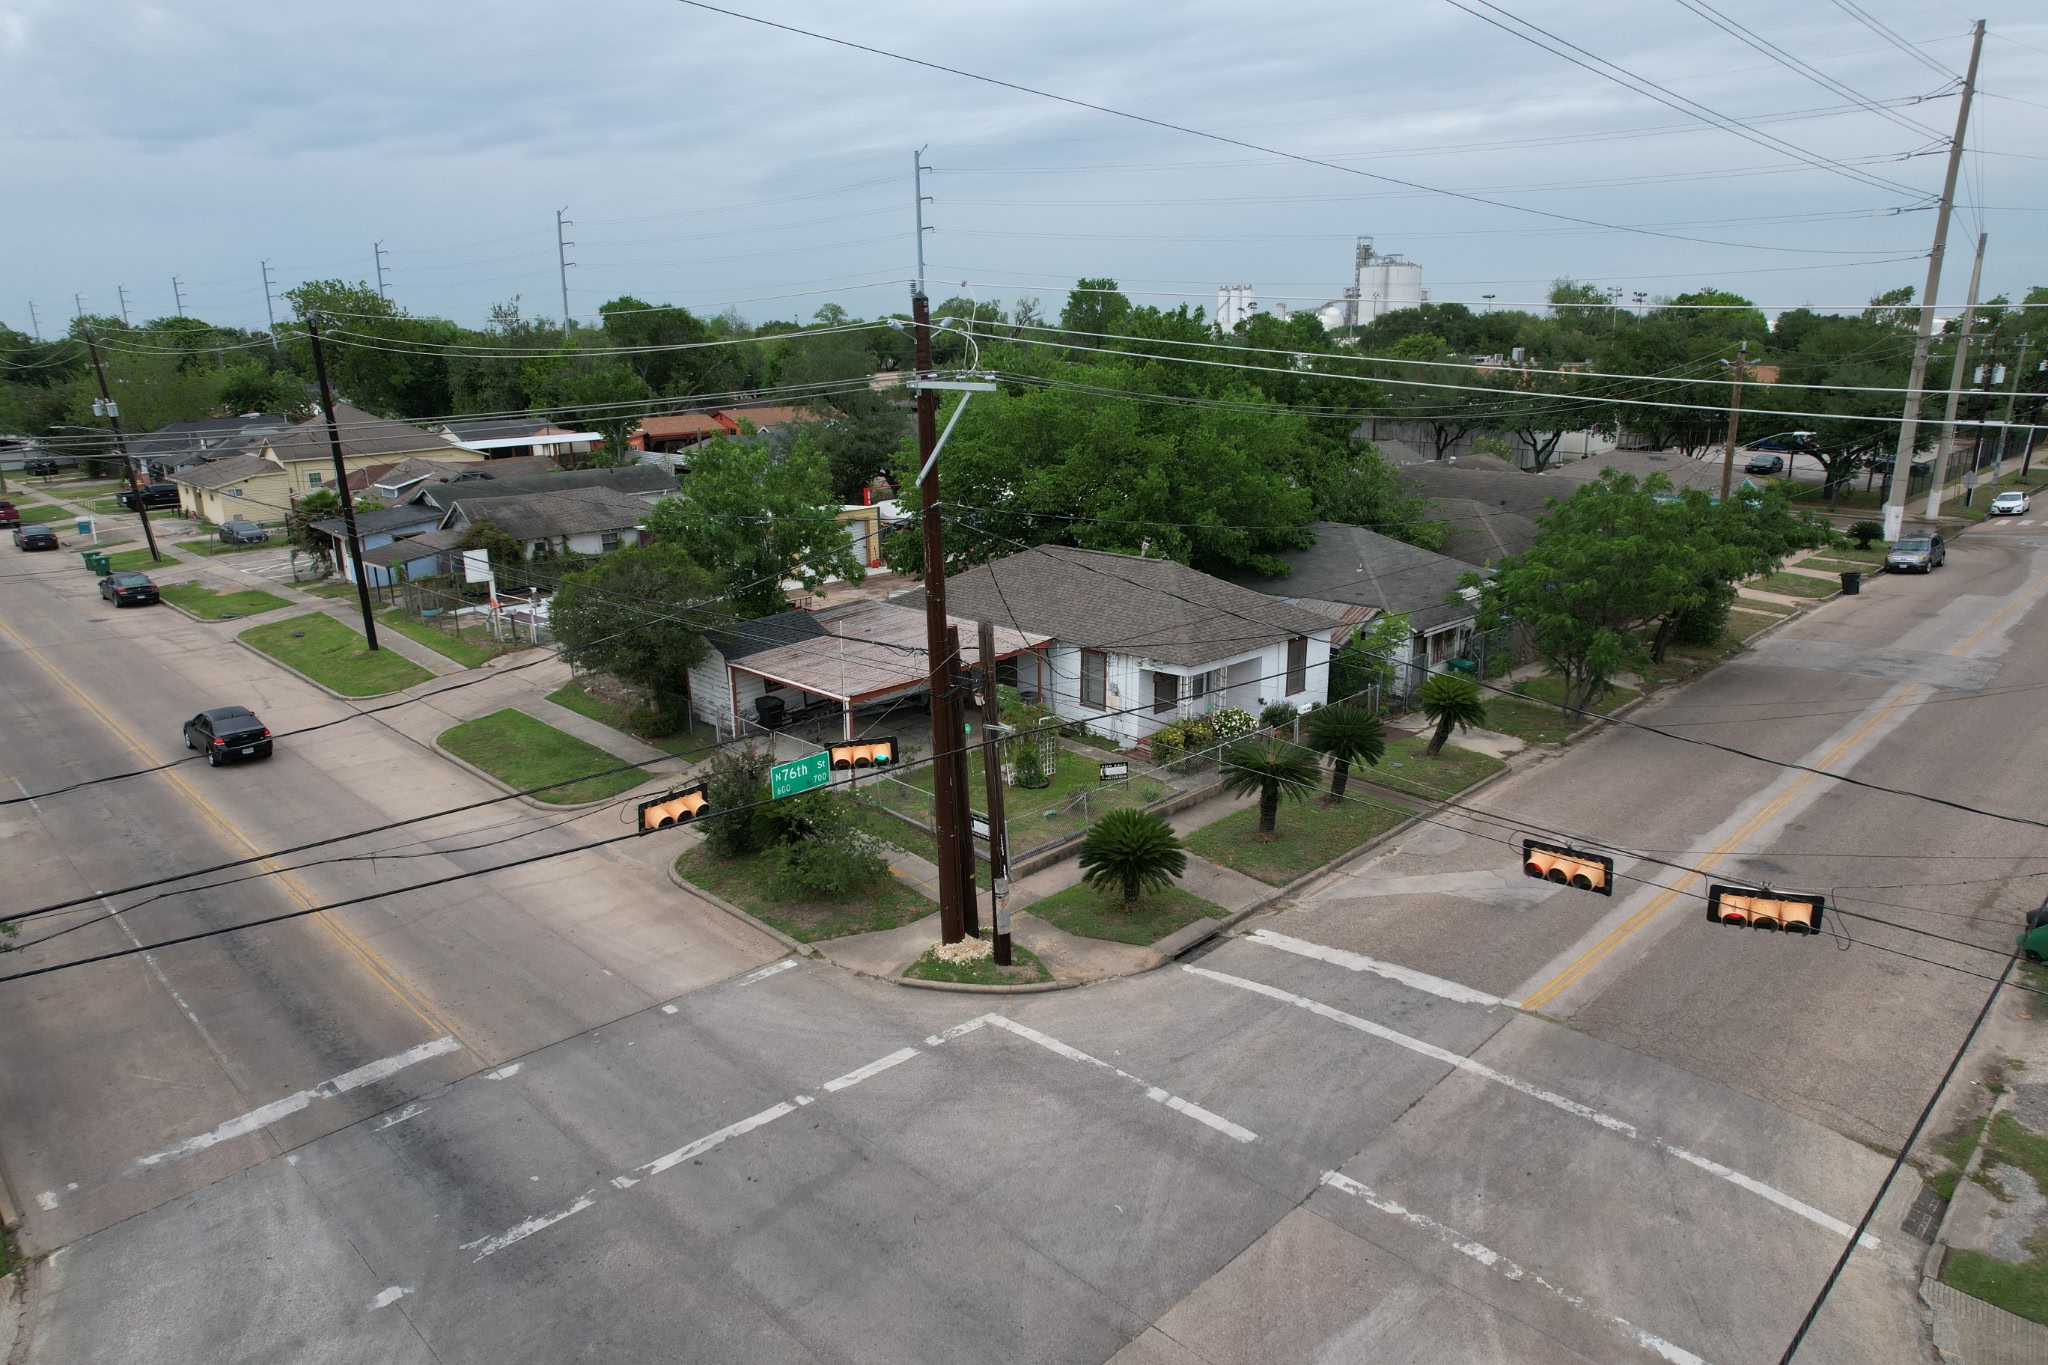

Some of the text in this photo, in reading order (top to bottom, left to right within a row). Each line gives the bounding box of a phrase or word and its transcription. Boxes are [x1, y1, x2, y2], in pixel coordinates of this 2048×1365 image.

[775, 760, 825, 782] N 76th St
[777, 772, 827, 795] 600 700
